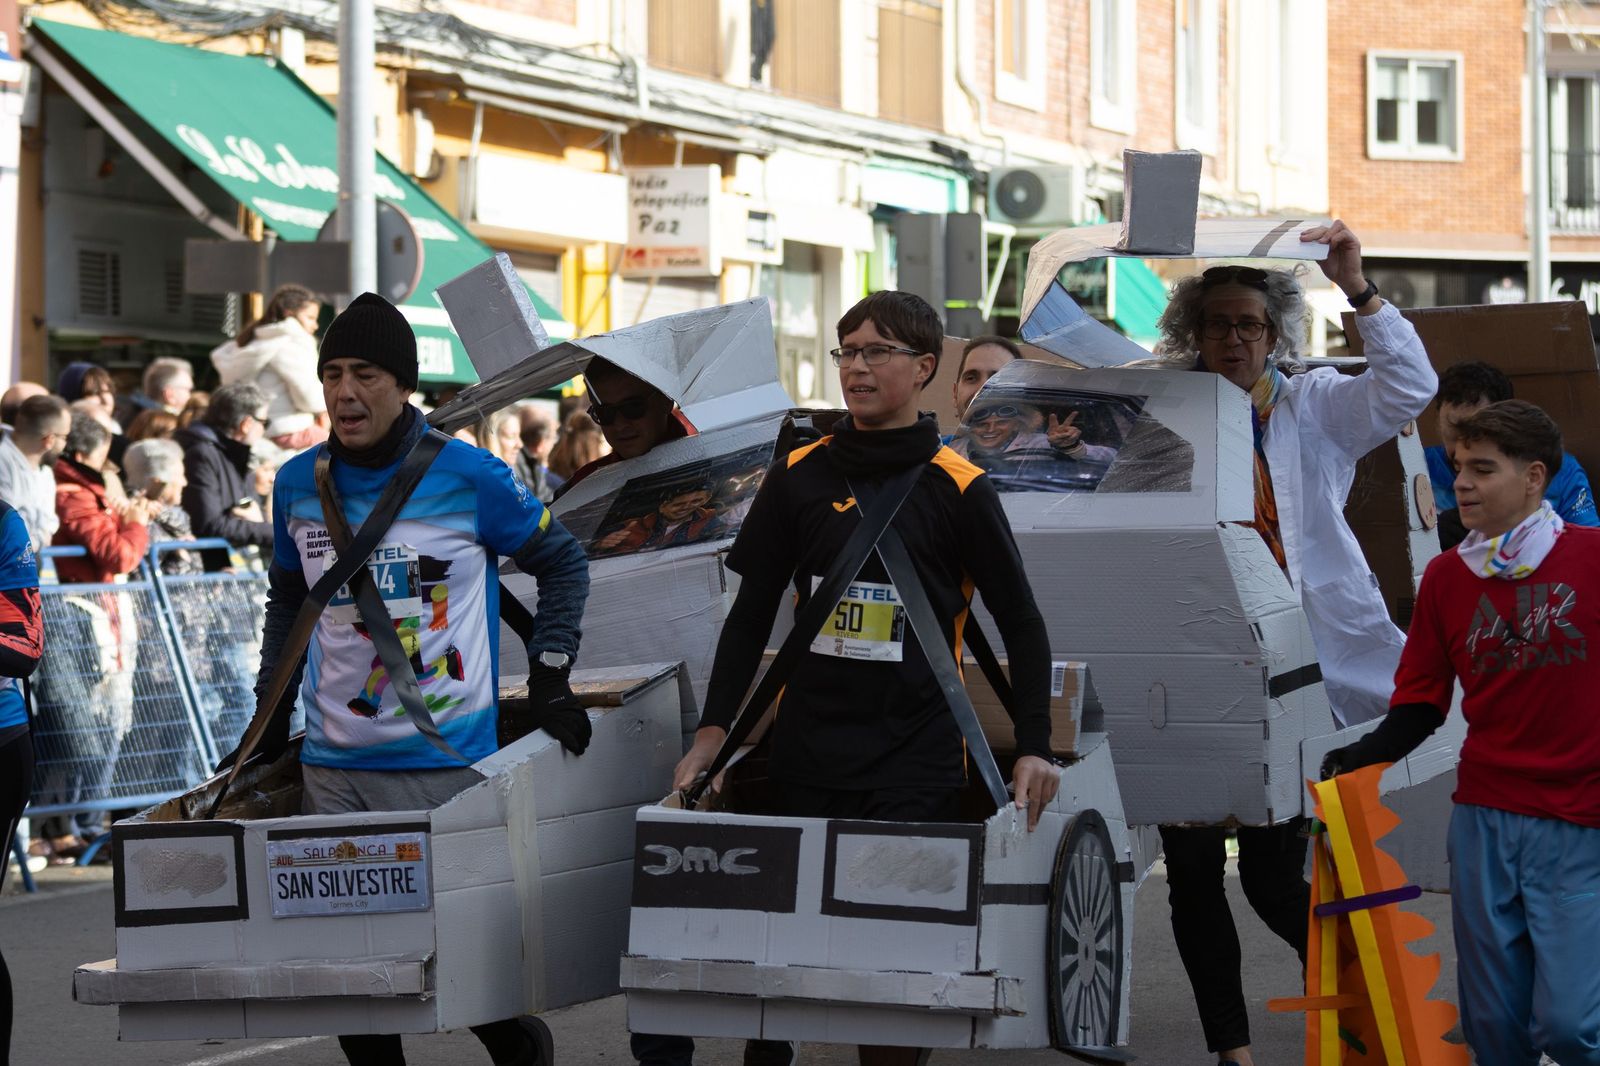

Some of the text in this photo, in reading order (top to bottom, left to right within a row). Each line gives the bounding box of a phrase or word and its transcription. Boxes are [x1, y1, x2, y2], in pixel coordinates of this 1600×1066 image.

[639, 214, 680, 236] Paz
[317, 530, 330, 538] SA
[844, 586, 897, 602] ETEL
[1466, 582, 1585, 653] AIR
[277, 867, 417, 900] SAN SILVESTRE
[355, 900, 369, 910] City
